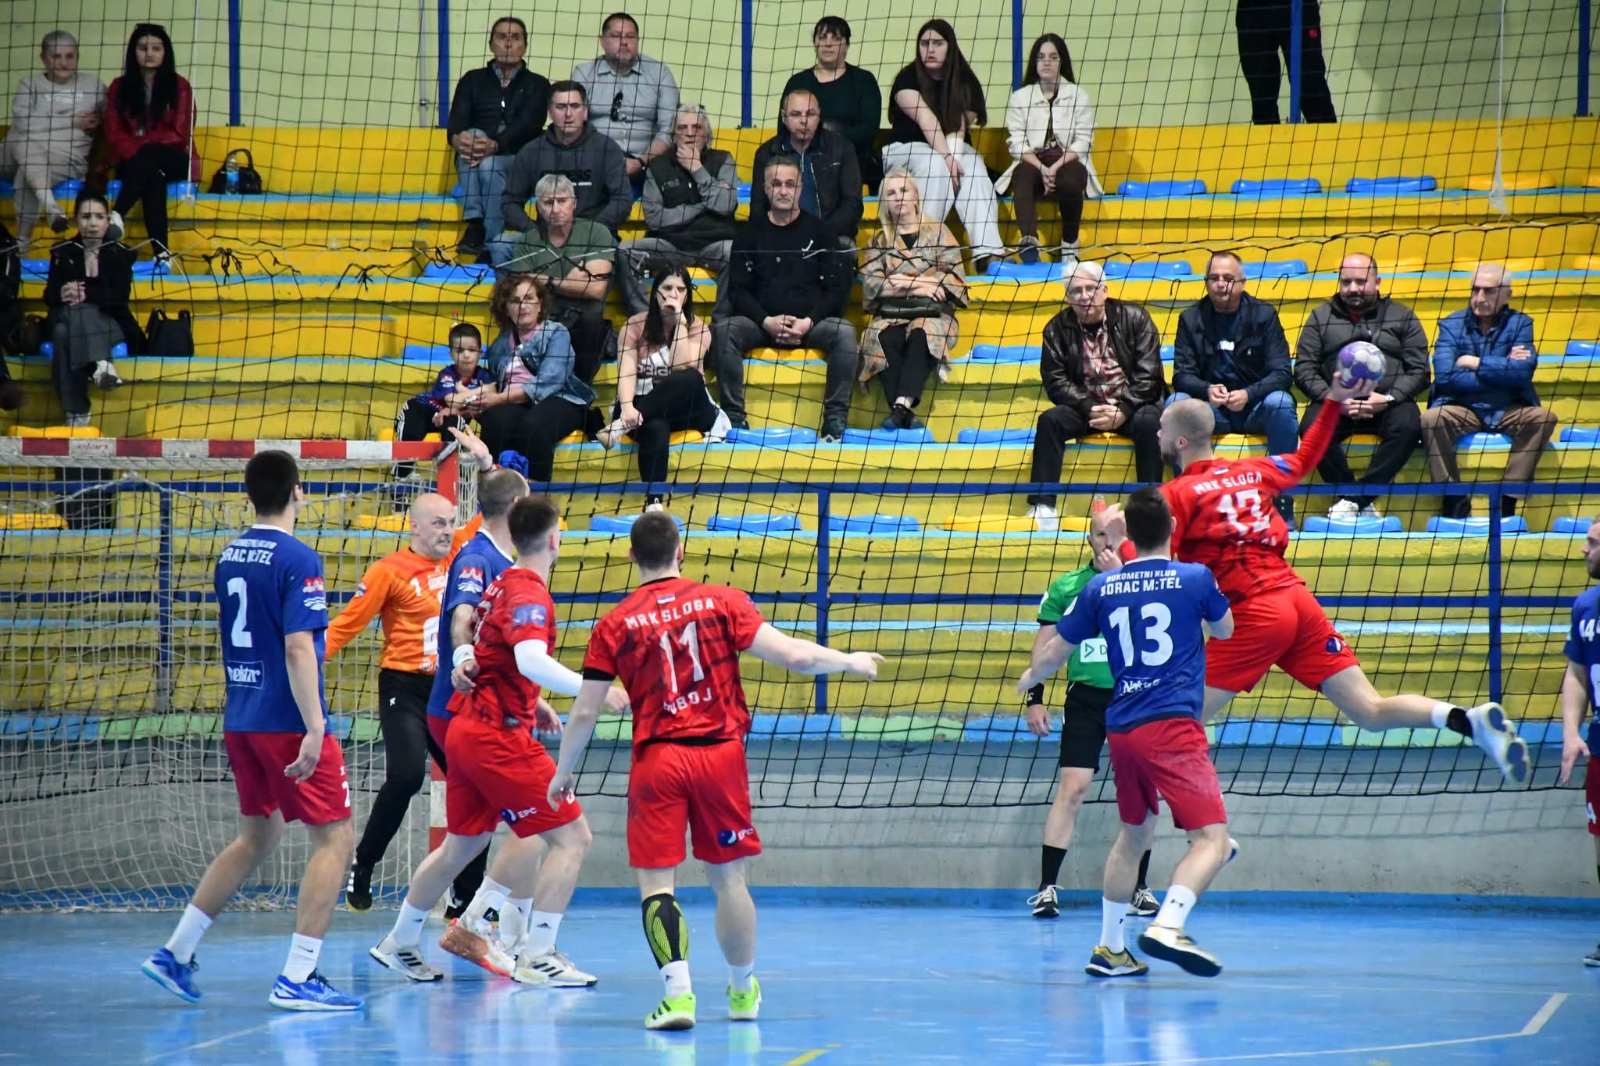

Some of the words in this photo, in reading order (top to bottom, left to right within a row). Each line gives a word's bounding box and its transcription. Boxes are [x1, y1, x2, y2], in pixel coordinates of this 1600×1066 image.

[1222, 471, 1263, 488] SLOGA
[1142, 577, 1183, 591] M:TEL
[227, 576, 253, 648] 2
[624, 611, 660, 631] MRK
[662, 597, 716, 624] SLOGA
[1108, 602, 1174, 668] 13
[659, 620, 705, 694] 11
[517, 807, 538, 819] EPC
